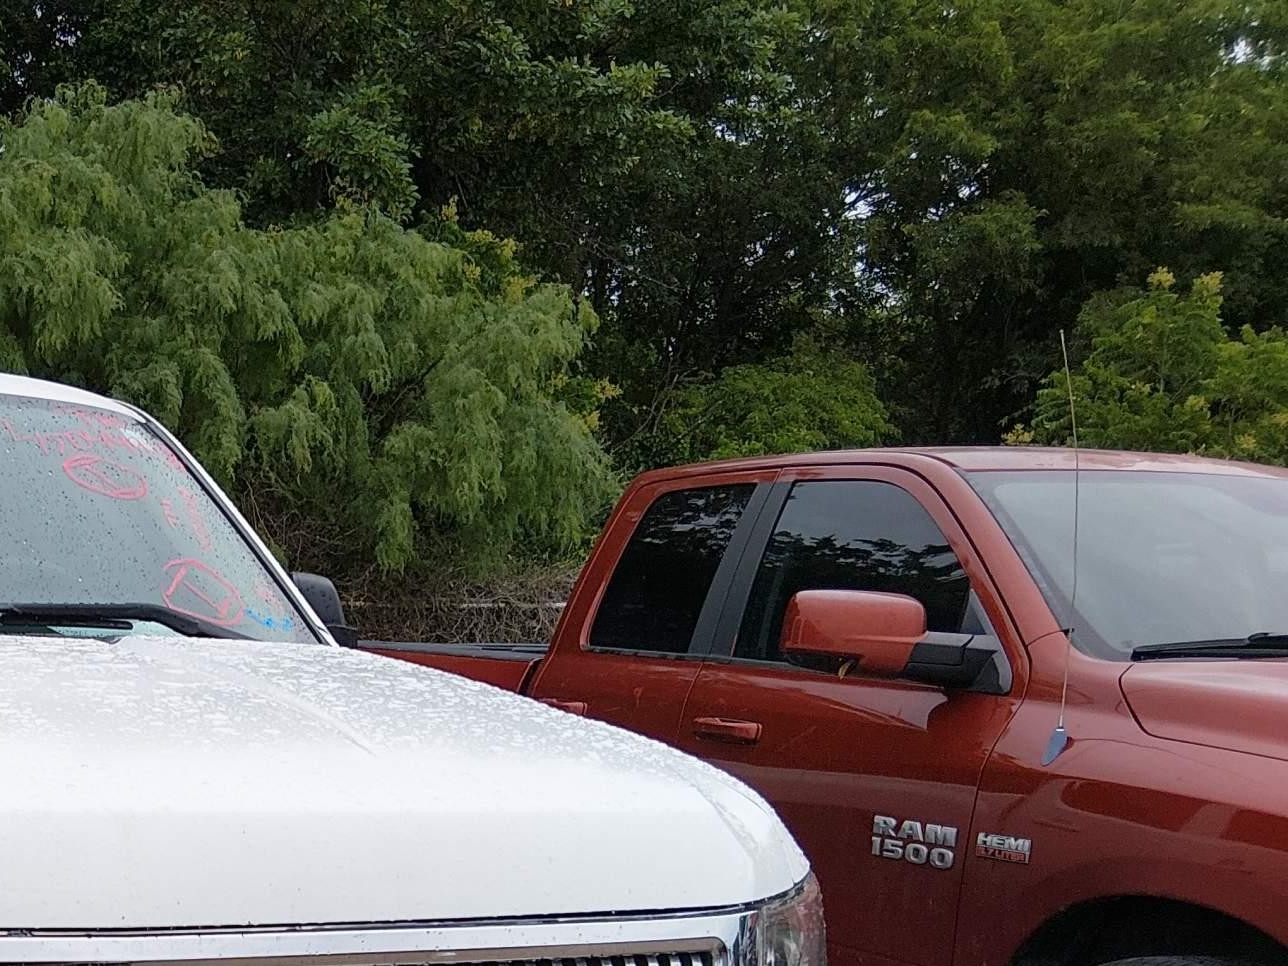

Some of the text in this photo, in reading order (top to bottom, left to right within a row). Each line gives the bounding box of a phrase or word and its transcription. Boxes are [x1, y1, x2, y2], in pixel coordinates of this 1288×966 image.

[872, 815, 958, 847] RAM
[977, 832, 1032, 853] HEMI
[871, 836, 955, 869] 1500
